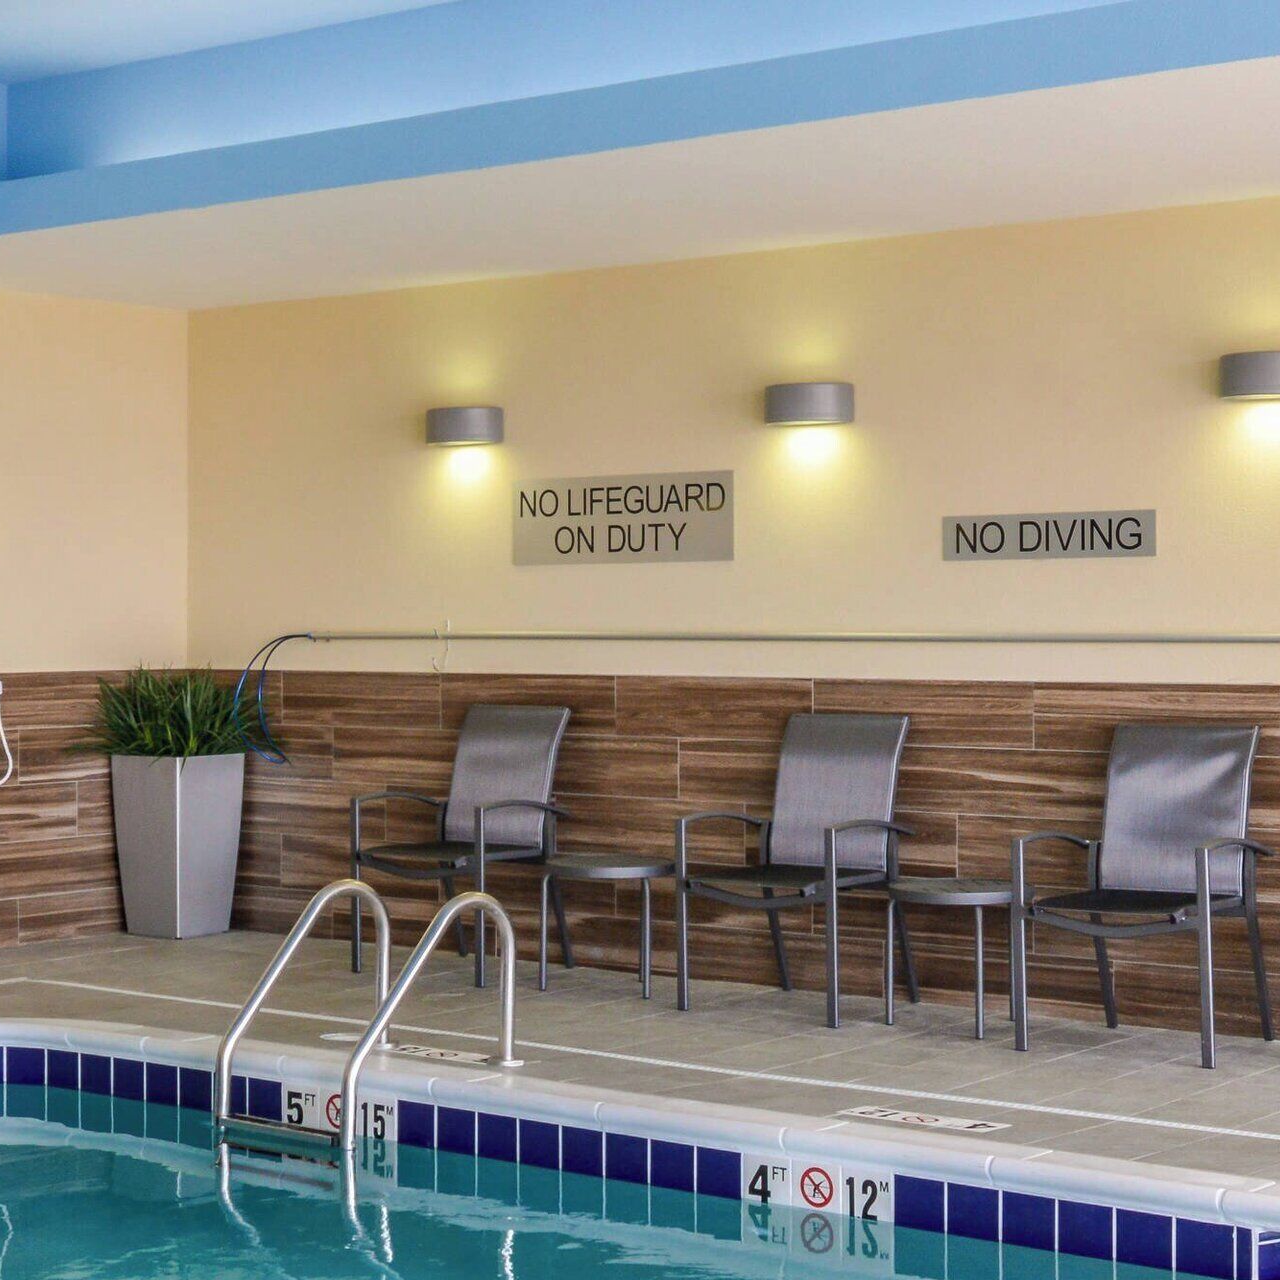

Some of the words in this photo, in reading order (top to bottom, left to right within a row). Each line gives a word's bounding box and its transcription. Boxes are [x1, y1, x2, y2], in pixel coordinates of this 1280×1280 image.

[520, 489, 559, 517] NO
[567, 482, 726, 517] LIFEGUARD
[554, 525, 595, 554] ON
[608, 522, 688, 553] DUTY
[955, 521, 1005, 554] NO
[1019, 517, 1143, 552] DIVING
[286, 1090, 304, 1125] 5
[304, 1093, 316, 1107] FT
[386, 1105, 394, 1116] M
[748, 1164, 772, 1203] 4
[772, 1166, 788, 1182] FT
[879, 1180, 890, 1194] M
